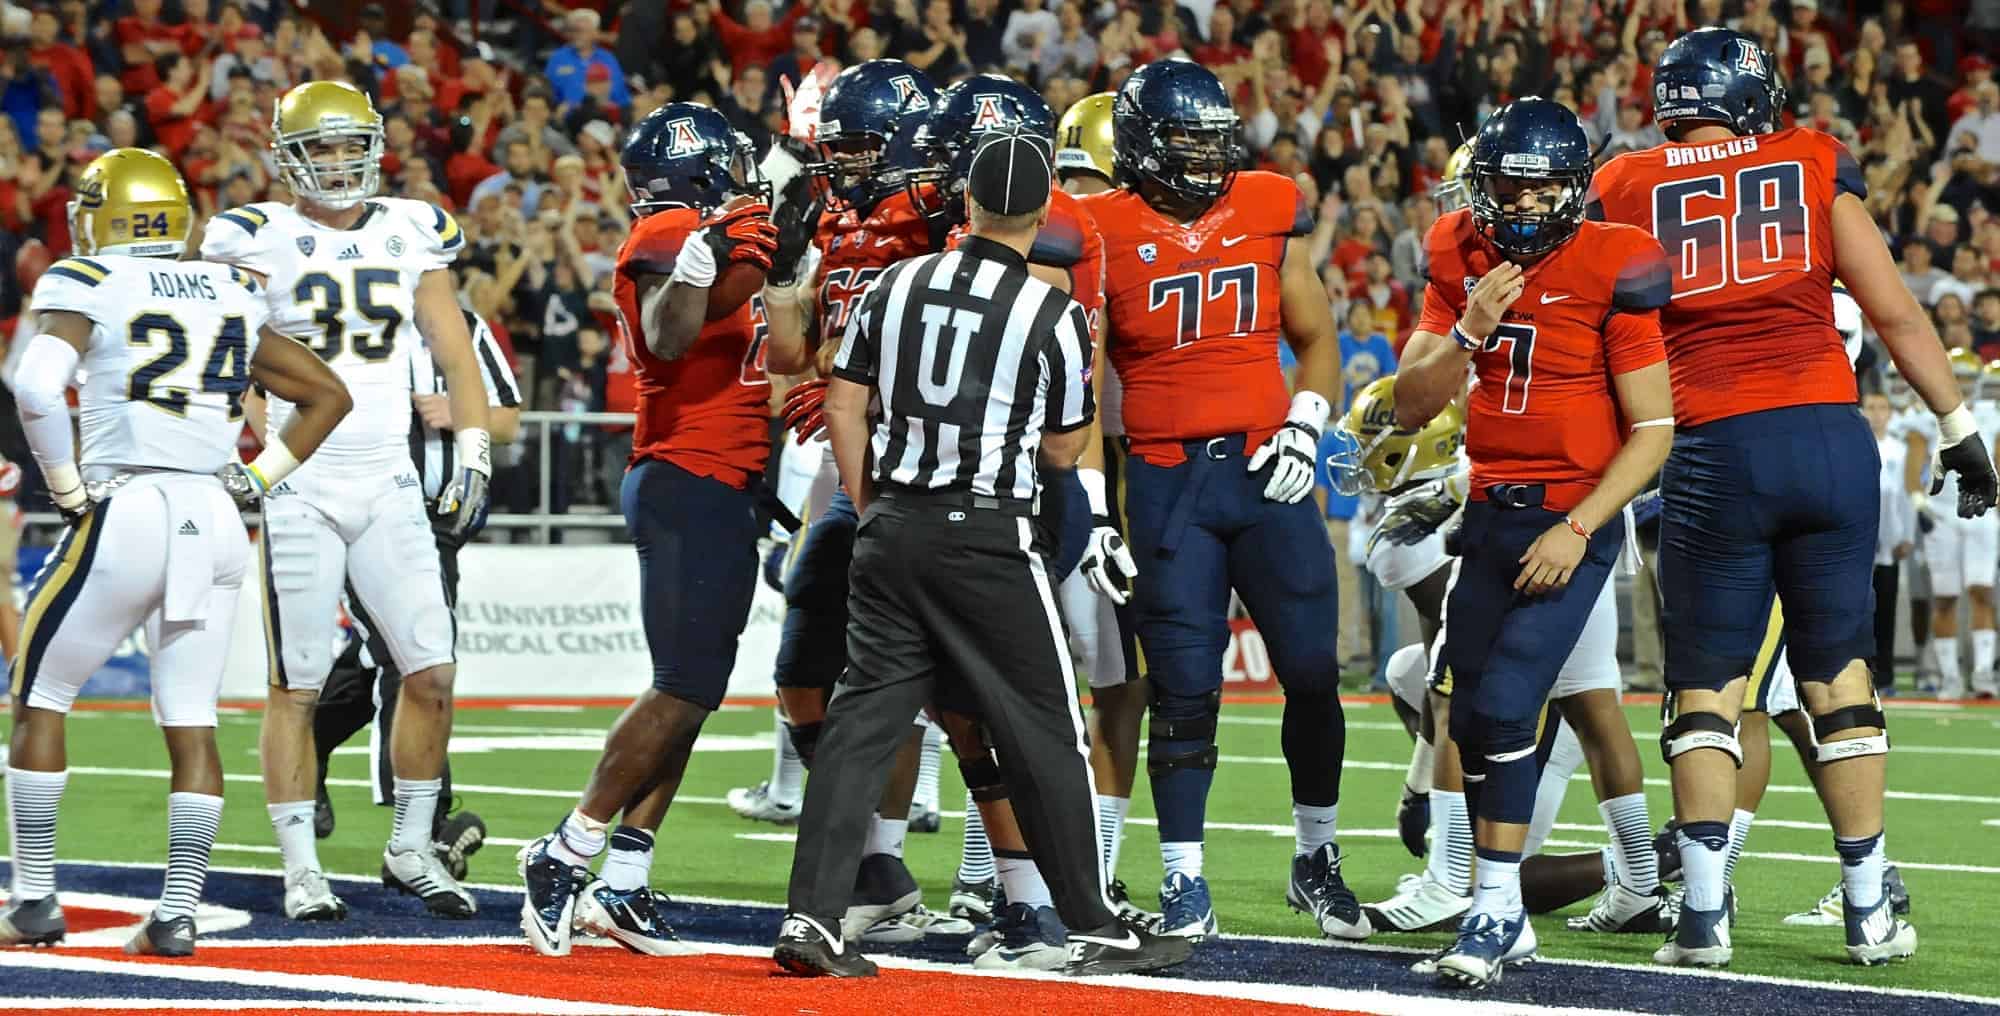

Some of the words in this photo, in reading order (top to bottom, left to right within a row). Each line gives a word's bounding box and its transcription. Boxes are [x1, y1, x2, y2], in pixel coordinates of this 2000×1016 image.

[1735, 38, 1767, 80] A
[888, 75, 930, 115] A
[969, 93, 1007, 134] A
[666, 117, 709, 160] A
[1066, 126, 1082, 148] 11
[1664, 136, 1759, 167] BAUCUS
[133, 212, 169, 238] 24
[1652, 161, 1812, 301] 68
[150, 271, 217, 300] ADAMS
[291, 266, 404, 365] 35
[1148, 263, 1258, 350] 77
[126, 309, 250, 423] 24
[917, 303, 984, 408] U
[1483, 322, 1537, 415] 7
[481, 601, 634, 628] UNIVERSITY
[555, 630, 649, 654] CENTE
